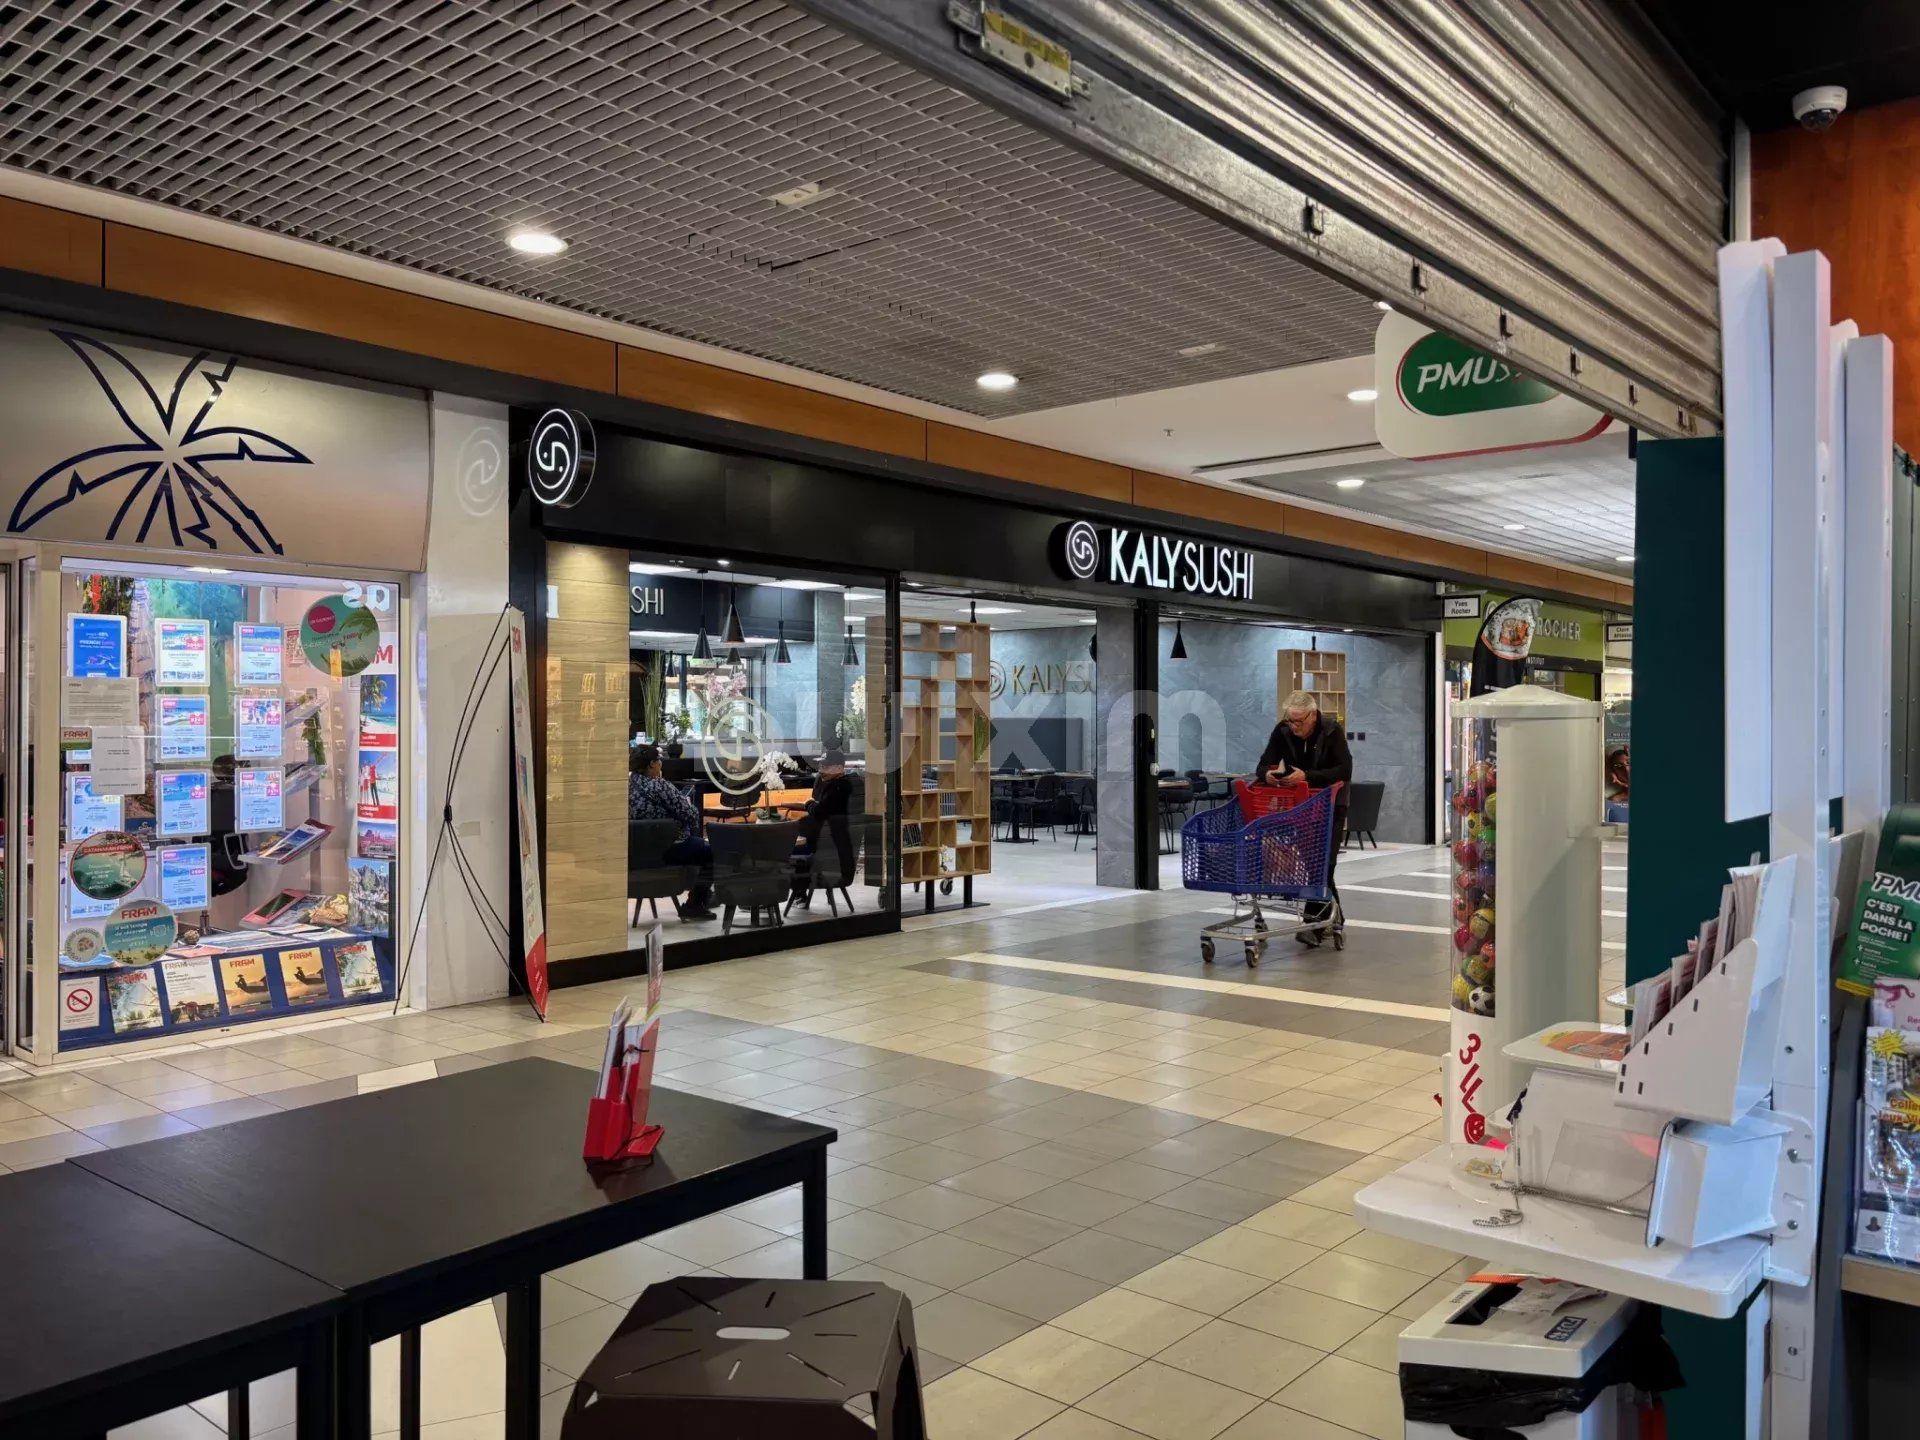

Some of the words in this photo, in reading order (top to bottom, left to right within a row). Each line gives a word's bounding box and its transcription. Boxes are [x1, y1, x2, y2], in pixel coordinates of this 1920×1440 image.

[1416, 356, 1498, 394] PMU
[1110, 527, 1254, 600] KALYSUSHI
[121, 907, 158, 920] FRAM
[1866, 898, 1901, 914] C'EST
[1863, 910, 1896, 926] DANS
[1897, 920, 1913, 931] LA
[229, 958, 254, 968] FRAM
[289, 951, 312, 960] FRAM
